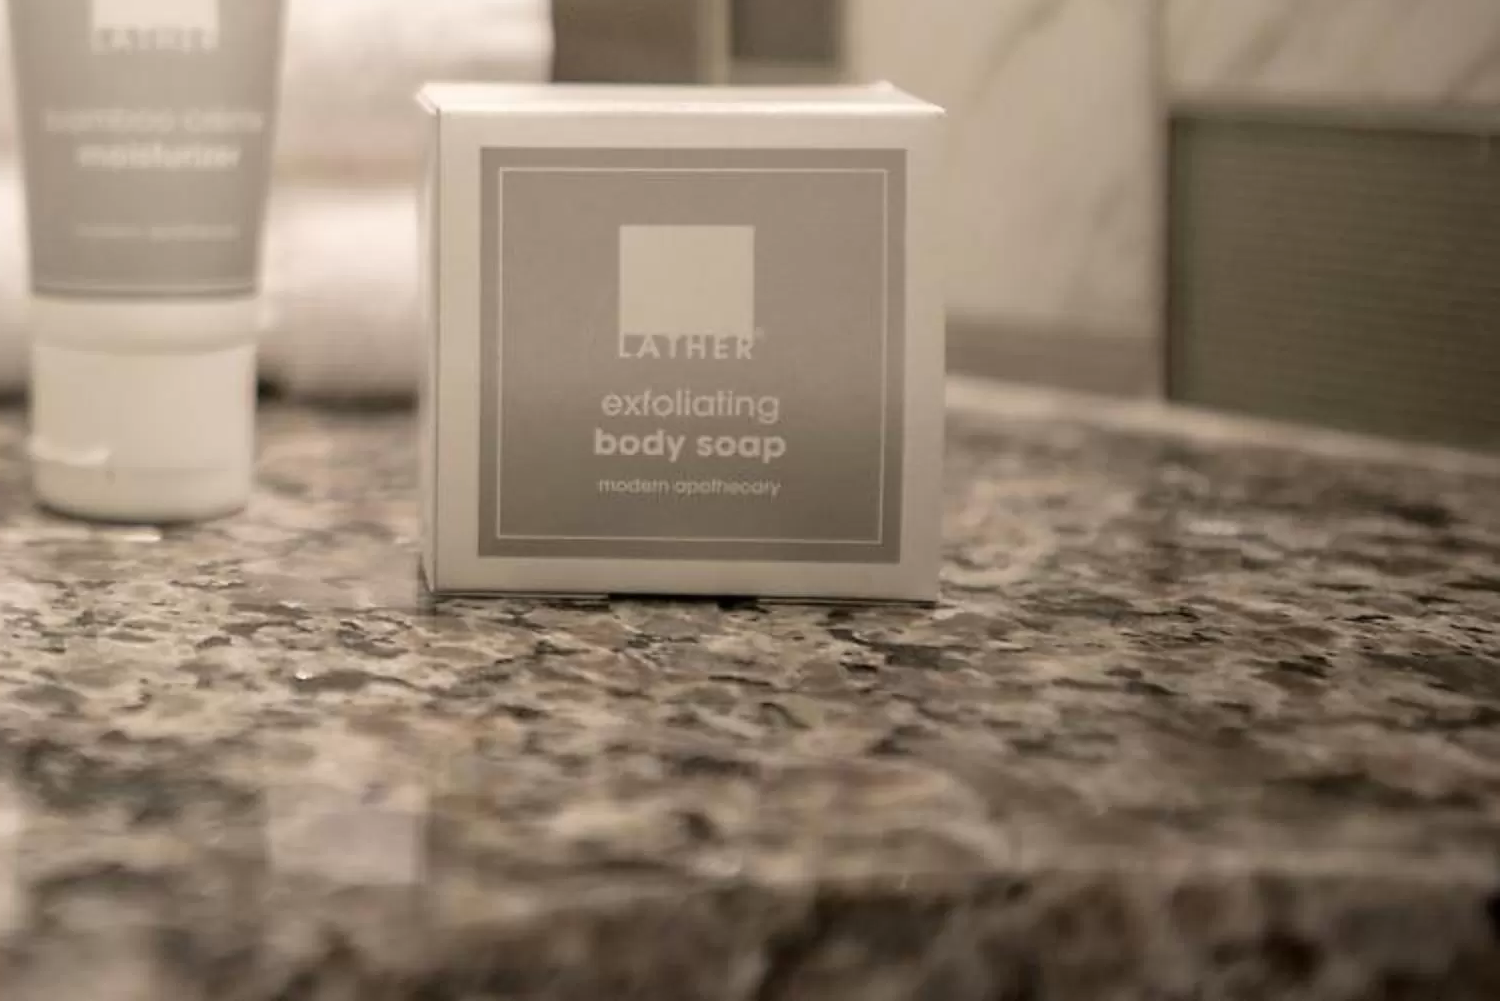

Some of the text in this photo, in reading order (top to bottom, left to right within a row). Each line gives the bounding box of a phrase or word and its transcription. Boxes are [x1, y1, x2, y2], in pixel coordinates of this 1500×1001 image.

[619, 334, 755, 359] LATHER
[601, 388, 780, 424] exfoliating
[594, 427, 787, 463] body soap
[598, 477, 781, 498] modern apothecary
